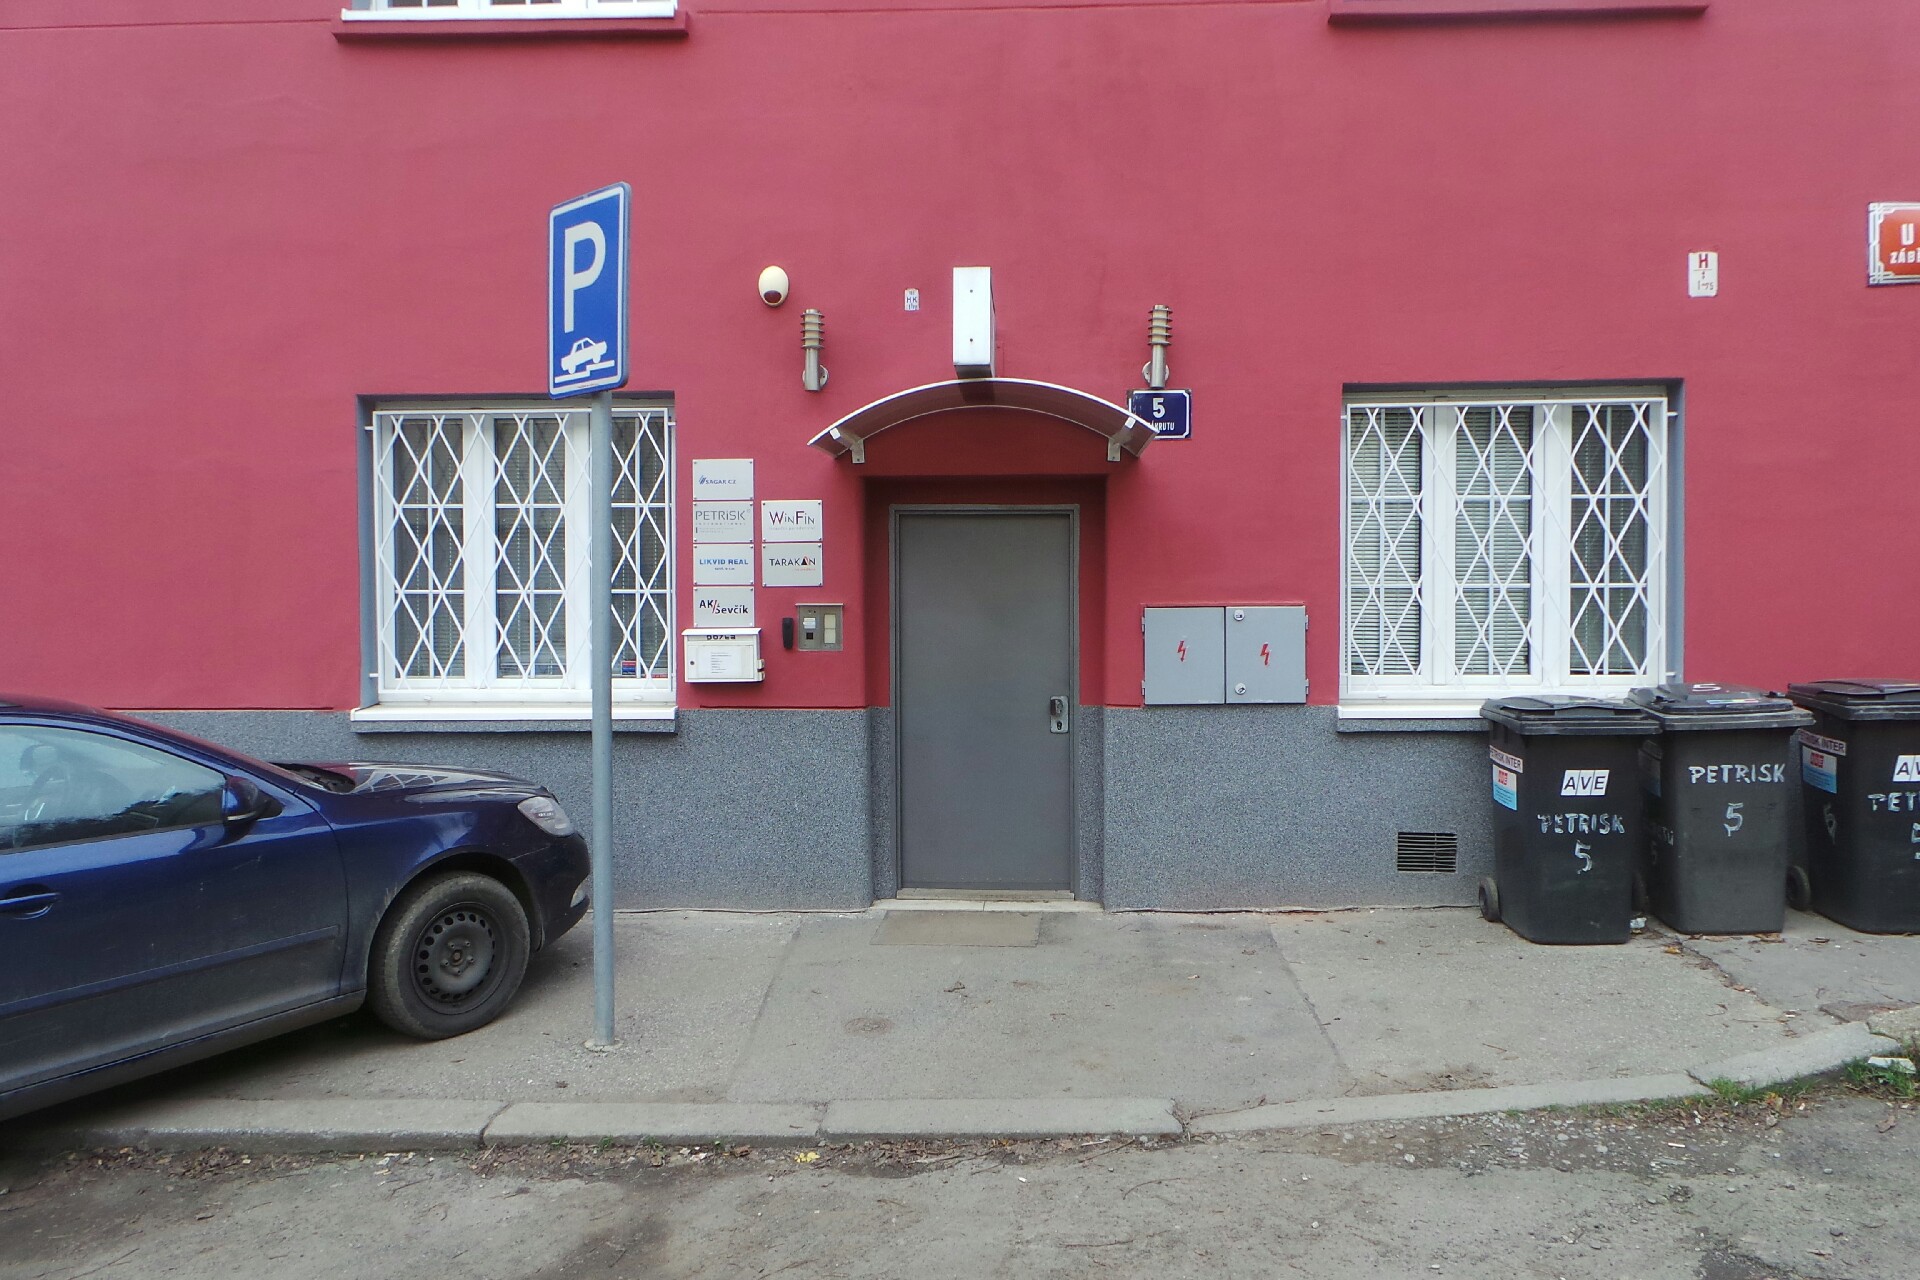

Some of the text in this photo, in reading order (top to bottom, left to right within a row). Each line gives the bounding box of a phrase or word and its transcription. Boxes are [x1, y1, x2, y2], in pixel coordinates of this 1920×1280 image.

[1901, 223, 1915, 245] U
[1698, 253, 1709, 268] H
[564, 221, 607, 334] P
[1153, 397, 1166, 419] 5
[699, 558, 749, 566] LIKVID REAL
[1563, 776, 1607, 791] AVE
[1687, 763, 1786, 784] PETRISK
[1867, 792, 1920, 812] PET
[1537, 813, 1625, 835] PETRISK
[1724, 802, 1744, 837] 5
[1574, 839, 1593, 873] 5
